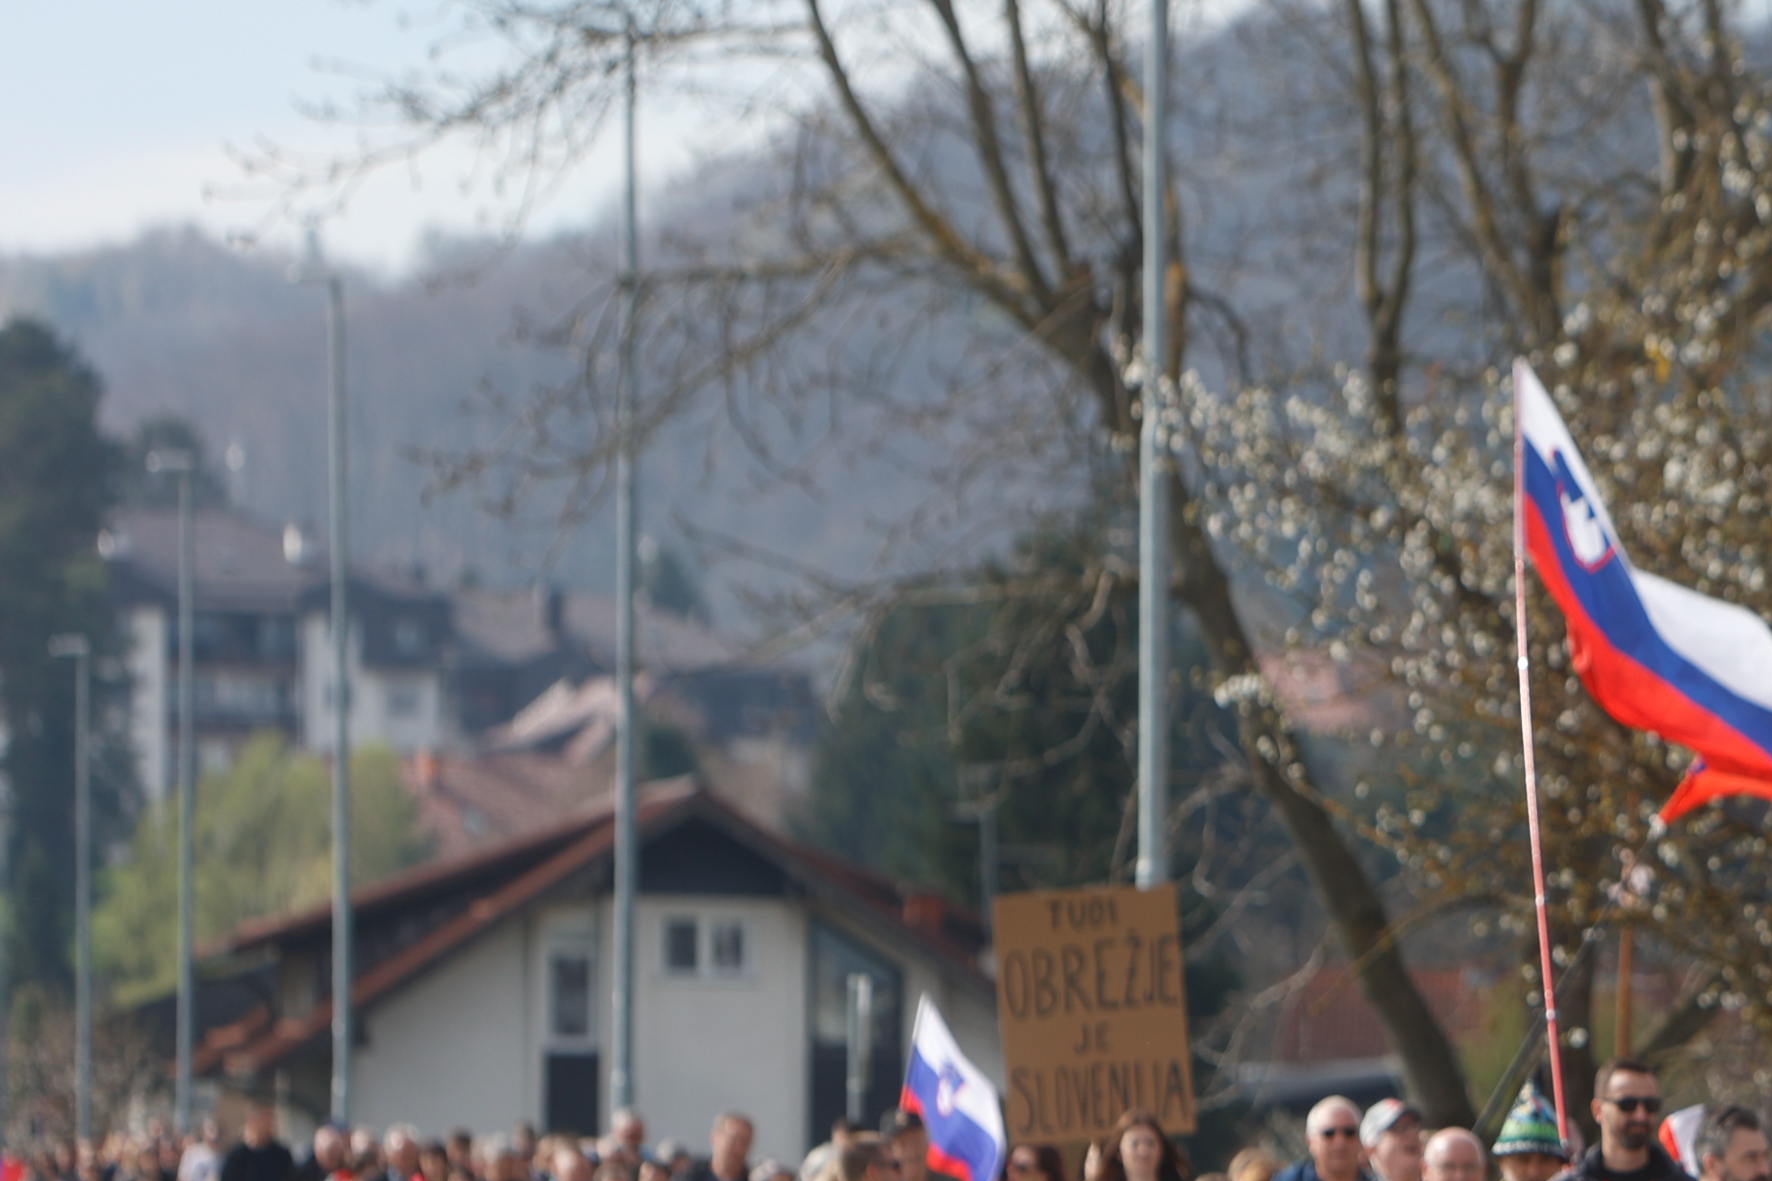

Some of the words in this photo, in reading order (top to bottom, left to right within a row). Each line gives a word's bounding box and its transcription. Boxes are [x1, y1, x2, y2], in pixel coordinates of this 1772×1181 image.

[1048, 897, 1118, 930] TUDI
[1073, 1022, 1109, 1054] JE
[1011, 1060, 1187, 1137] SLOVENIJA
